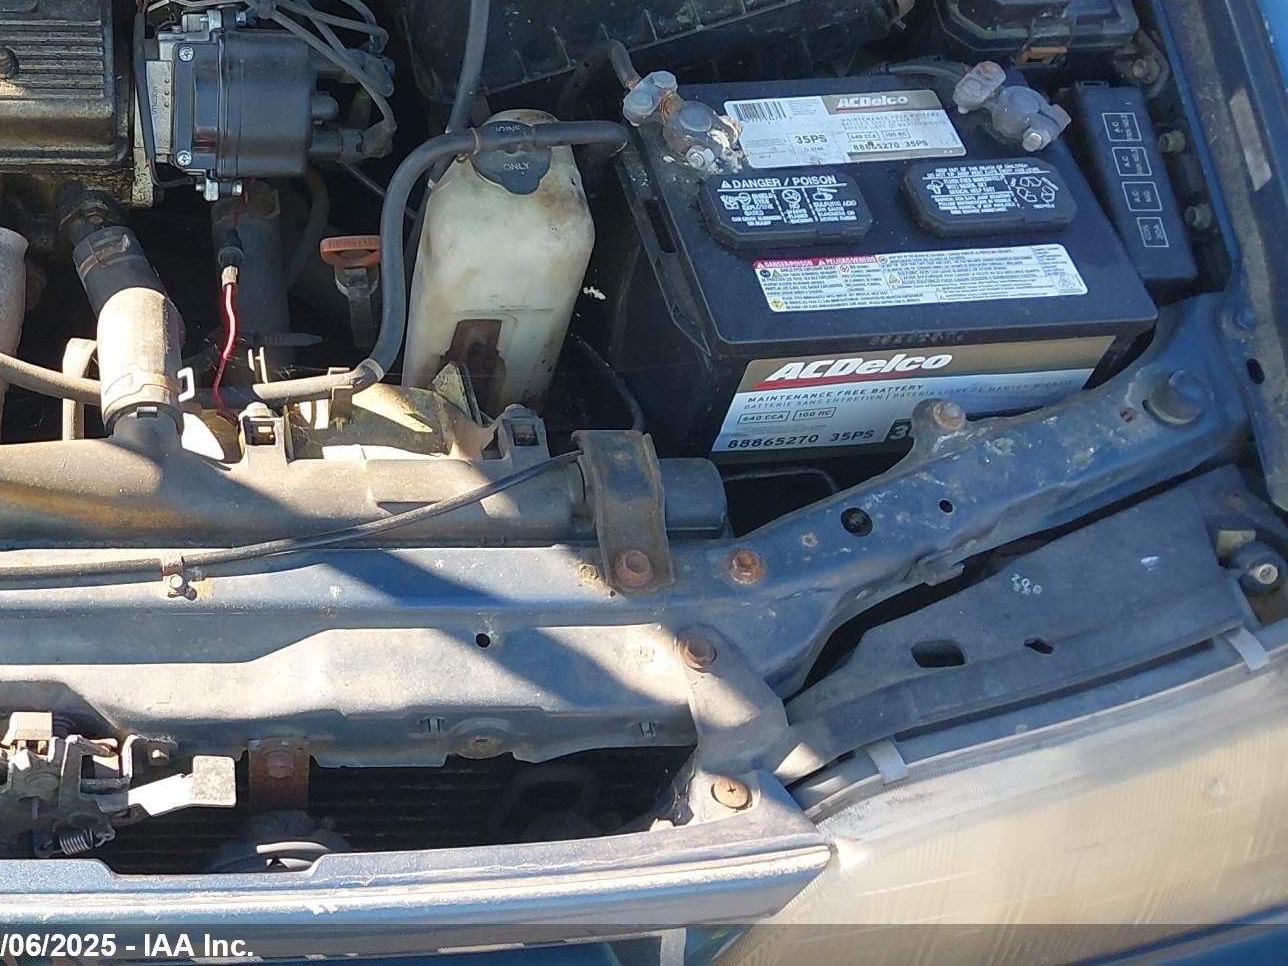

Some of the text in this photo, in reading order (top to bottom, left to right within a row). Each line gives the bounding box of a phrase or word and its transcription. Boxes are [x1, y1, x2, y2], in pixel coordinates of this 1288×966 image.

[838, 95, 908, 109] ACDelco
[795, 134, 828, 145] 35PS
[905, 139, 929, 148] 35PS
[503, 162, 529, 171] ONLY
[732, 177, 781, 188] DANGER
[792, 175, 837, 185] POISON
[764, 354, 953, 382] ACDelco
[748, 391, 833, 403] MAINTENANCE
[872, 384, 925, 393] BATTERY
[764, 413, 785, 421] CCA
[728, 435, 819, 449] 88865270
[830, 429, 874, 442] 35PS
